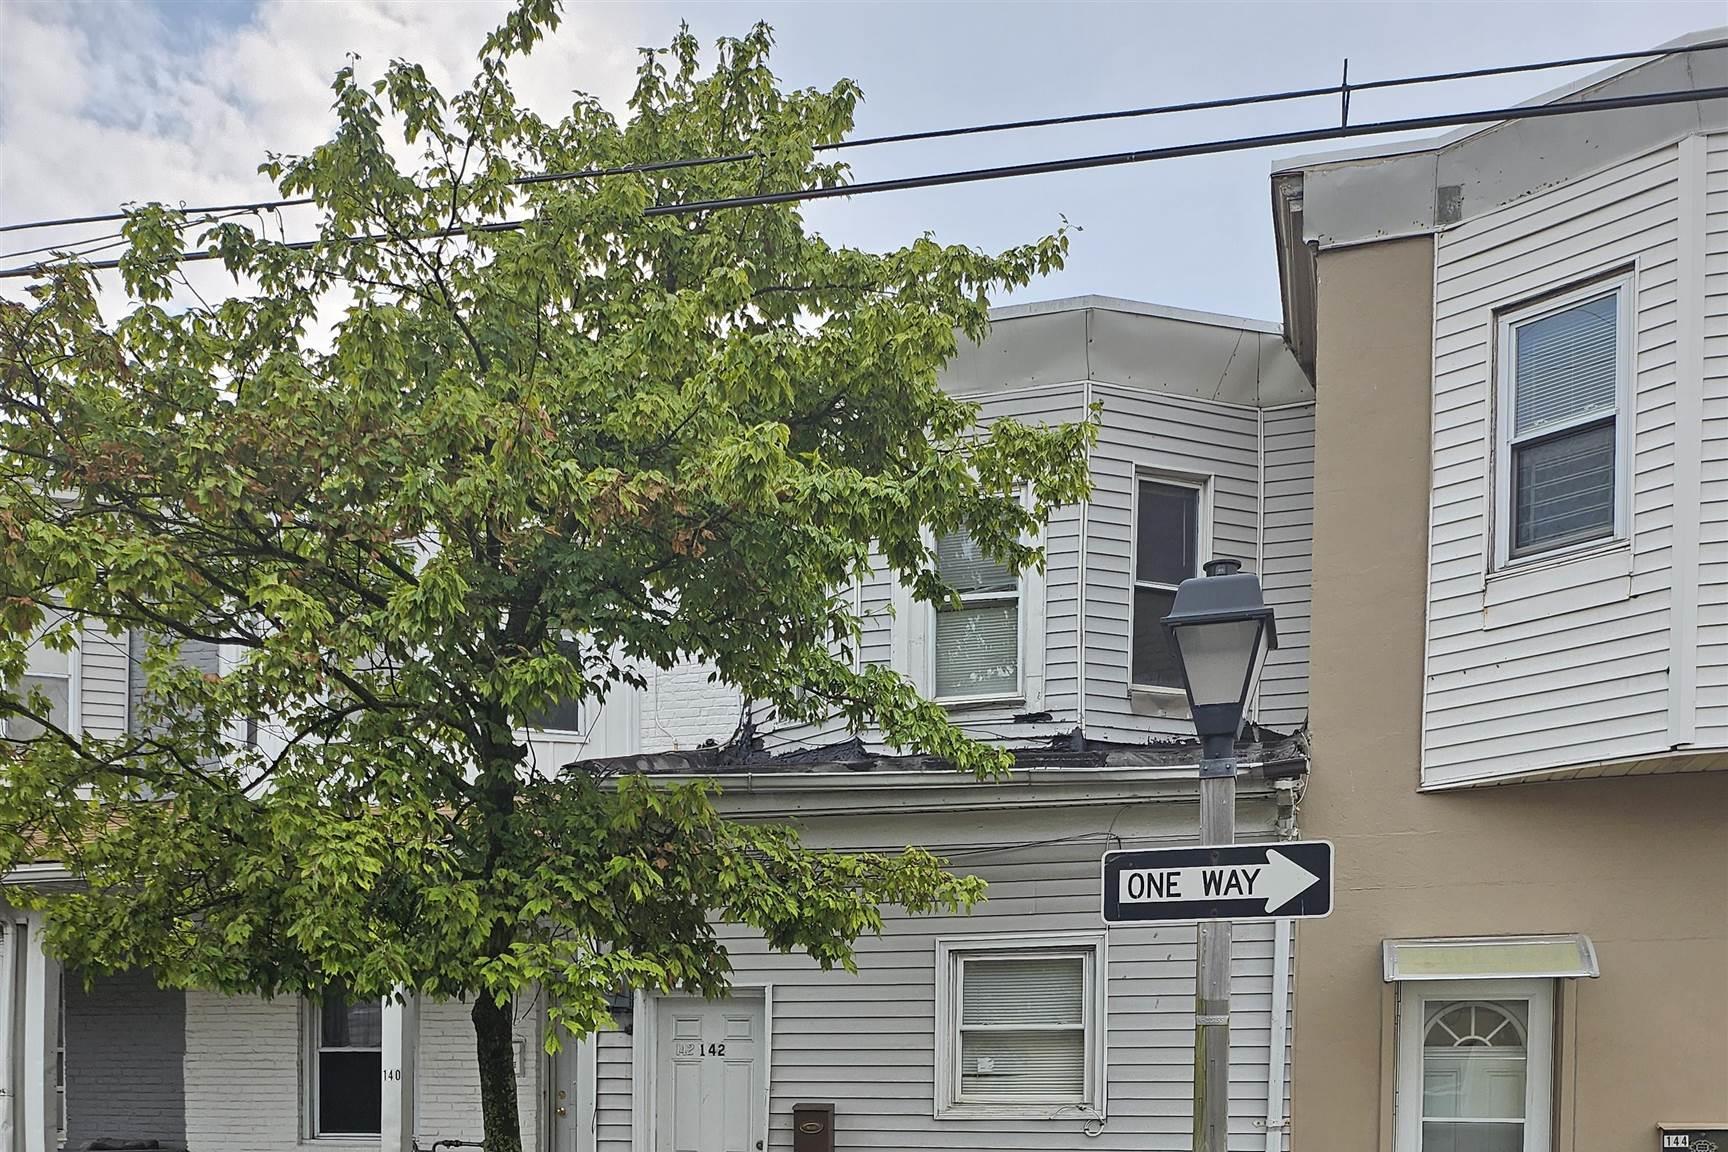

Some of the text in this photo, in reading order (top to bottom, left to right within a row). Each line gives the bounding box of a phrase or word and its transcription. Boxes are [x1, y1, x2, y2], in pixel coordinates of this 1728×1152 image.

[1127, 868, 1262, 899] ONE WAY
[700, 1043, 726, 1057] 142
[383, 1069, 401, 1081] 140
[1666, 1136, 1687, 1147] 144
